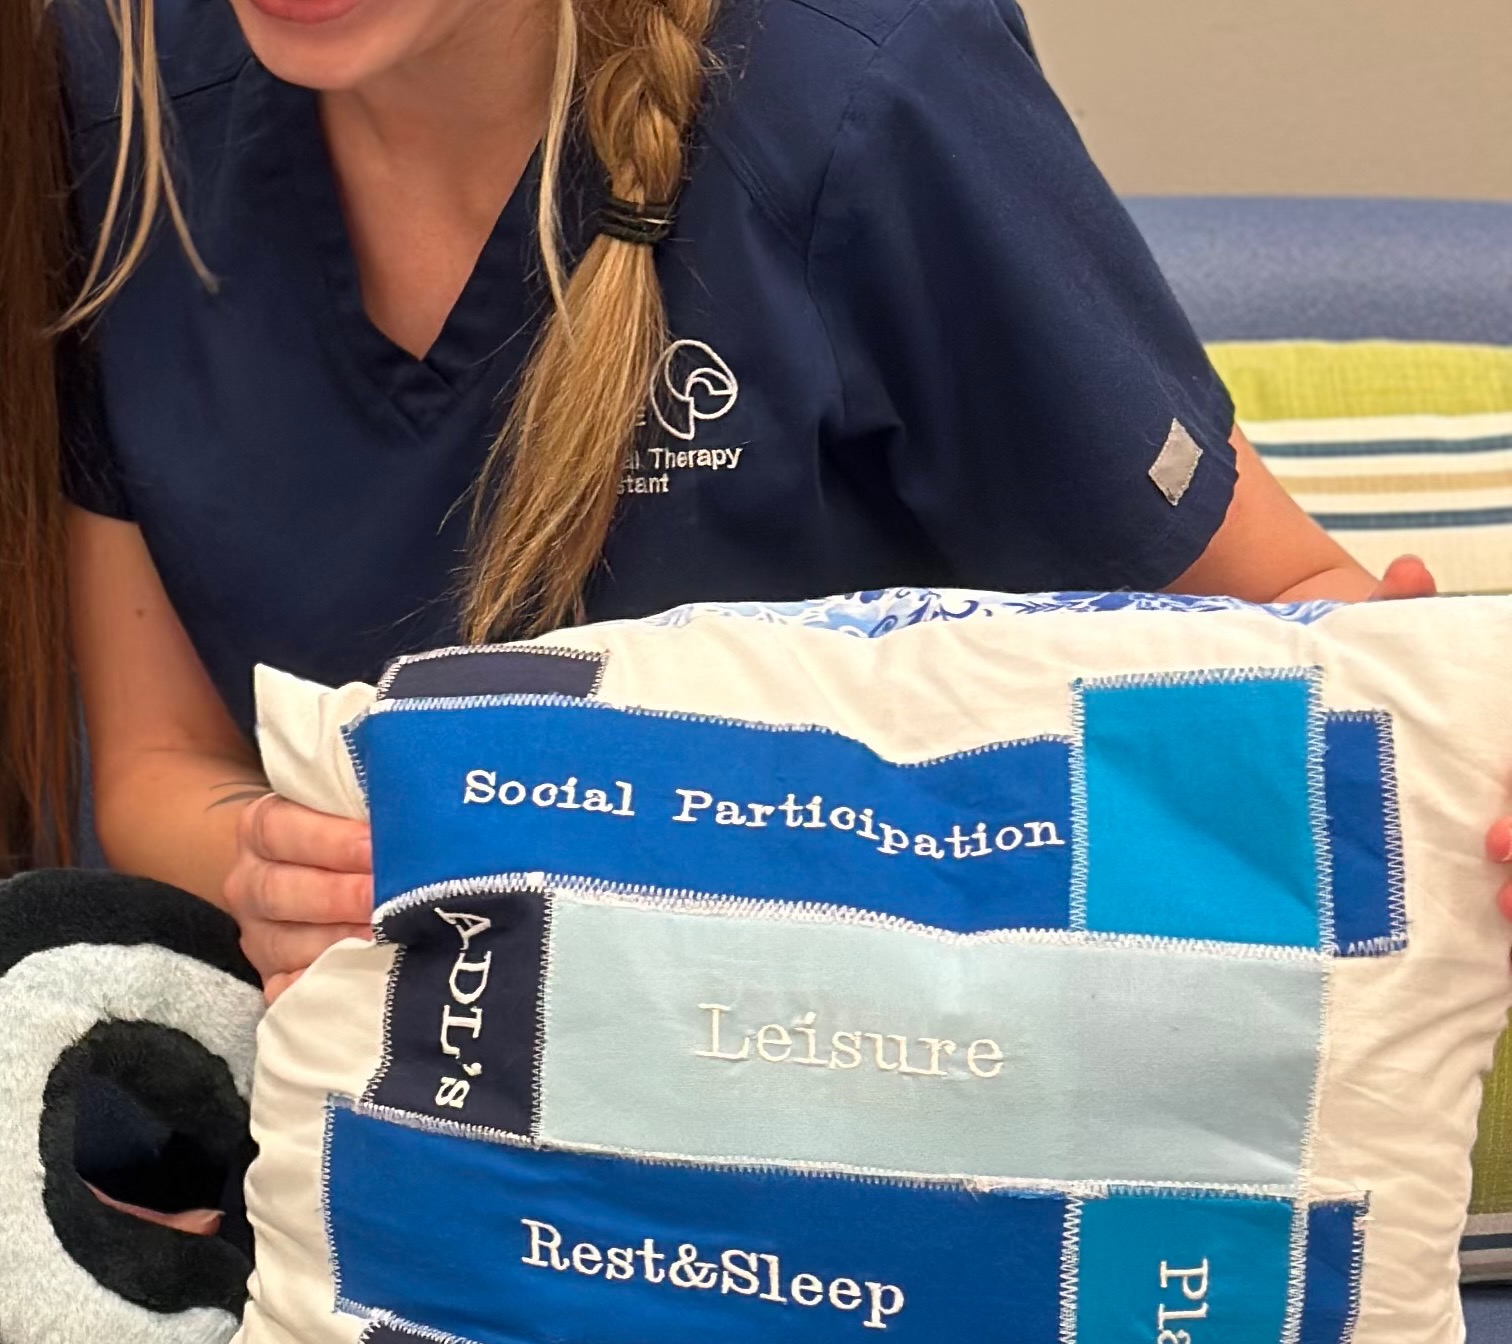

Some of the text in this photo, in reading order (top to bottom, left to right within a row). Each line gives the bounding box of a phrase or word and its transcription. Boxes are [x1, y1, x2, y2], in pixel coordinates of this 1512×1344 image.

[647, 446, 743, 471] Therapy
[463, 768, 1066, 862] Social Participation
[433, 906, 492, 1109] ADL's
[696, 1002, 1006, 1080] Leisure
[521, 1219, 905, 1330] Rest&Sleep
